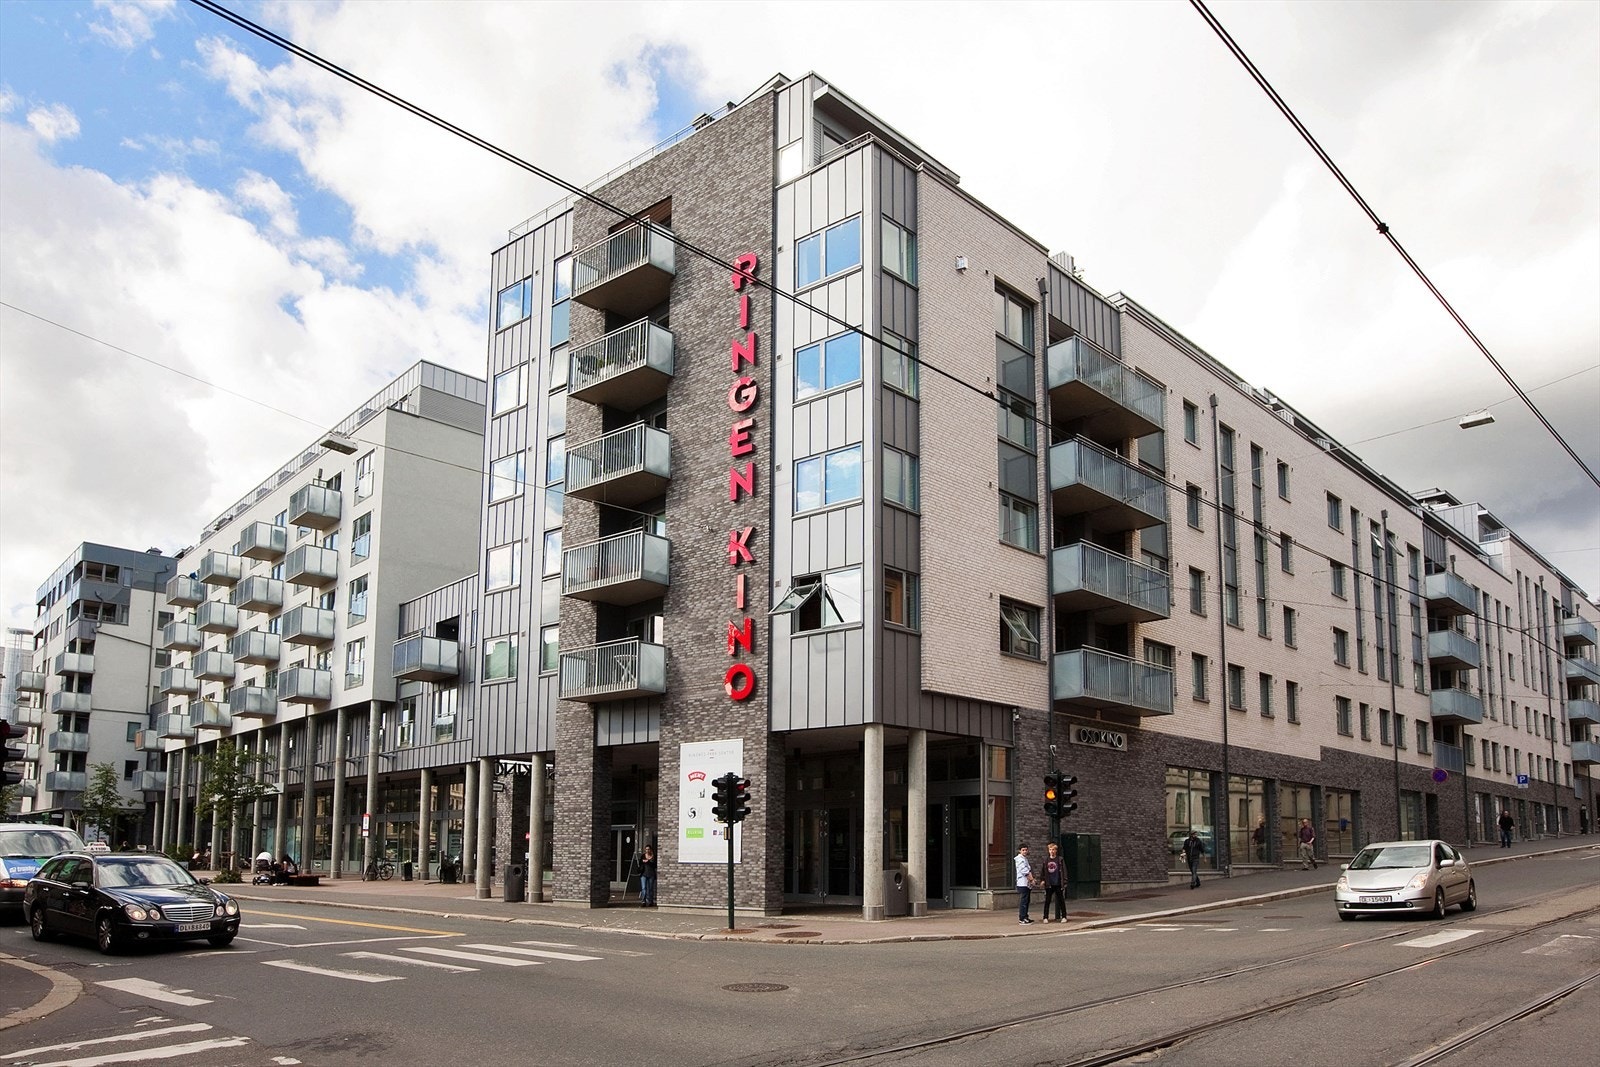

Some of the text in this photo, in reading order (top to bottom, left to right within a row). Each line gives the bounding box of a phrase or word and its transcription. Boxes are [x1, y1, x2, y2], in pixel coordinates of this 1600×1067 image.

[724, 252, 758, 700] RINGEN KINO
[1101, 731, 1123, 748] KINO
